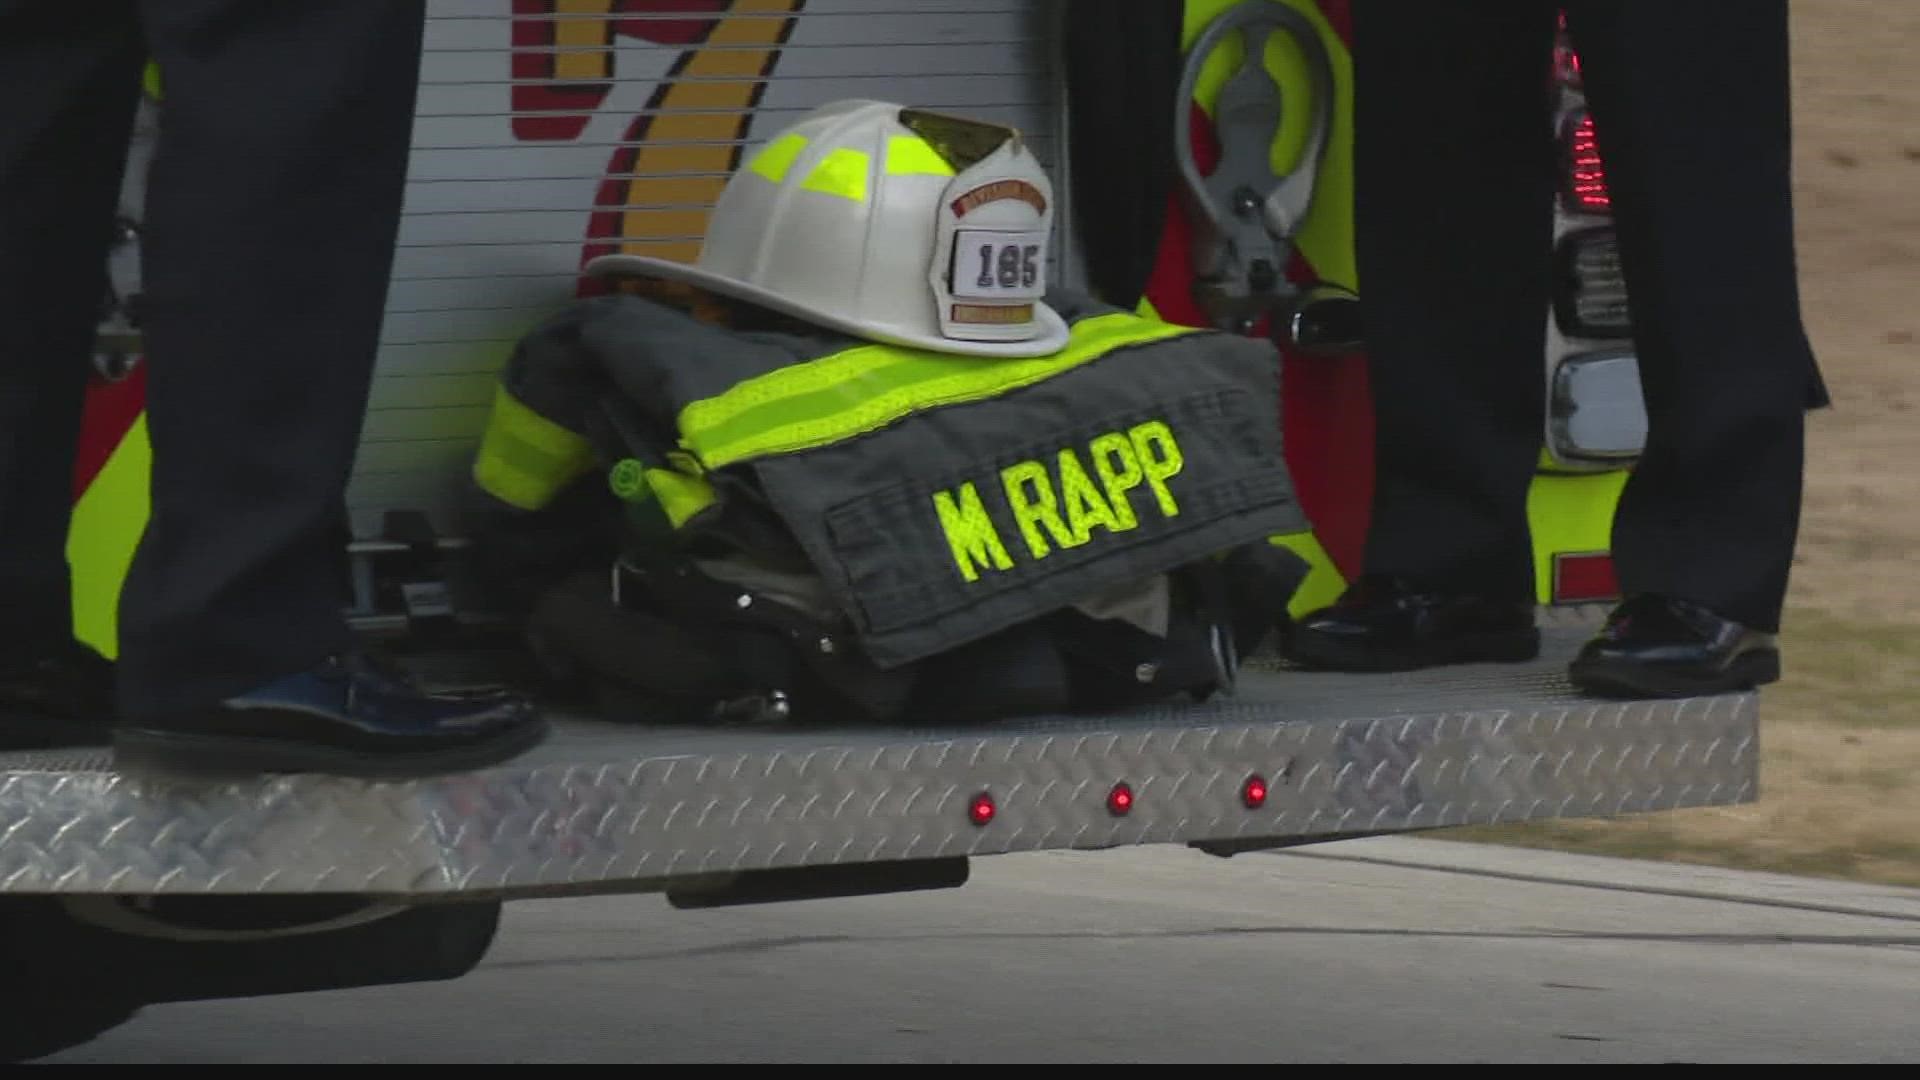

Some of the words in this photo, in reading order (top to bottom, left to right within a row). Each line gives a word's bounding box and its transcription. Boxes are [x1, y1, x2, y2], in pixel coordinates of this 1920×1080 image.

[976, 244, 1040, 288] 185
[932, 481, 1015, 583] M
[1000, 420, 1184, 560] RAPP
